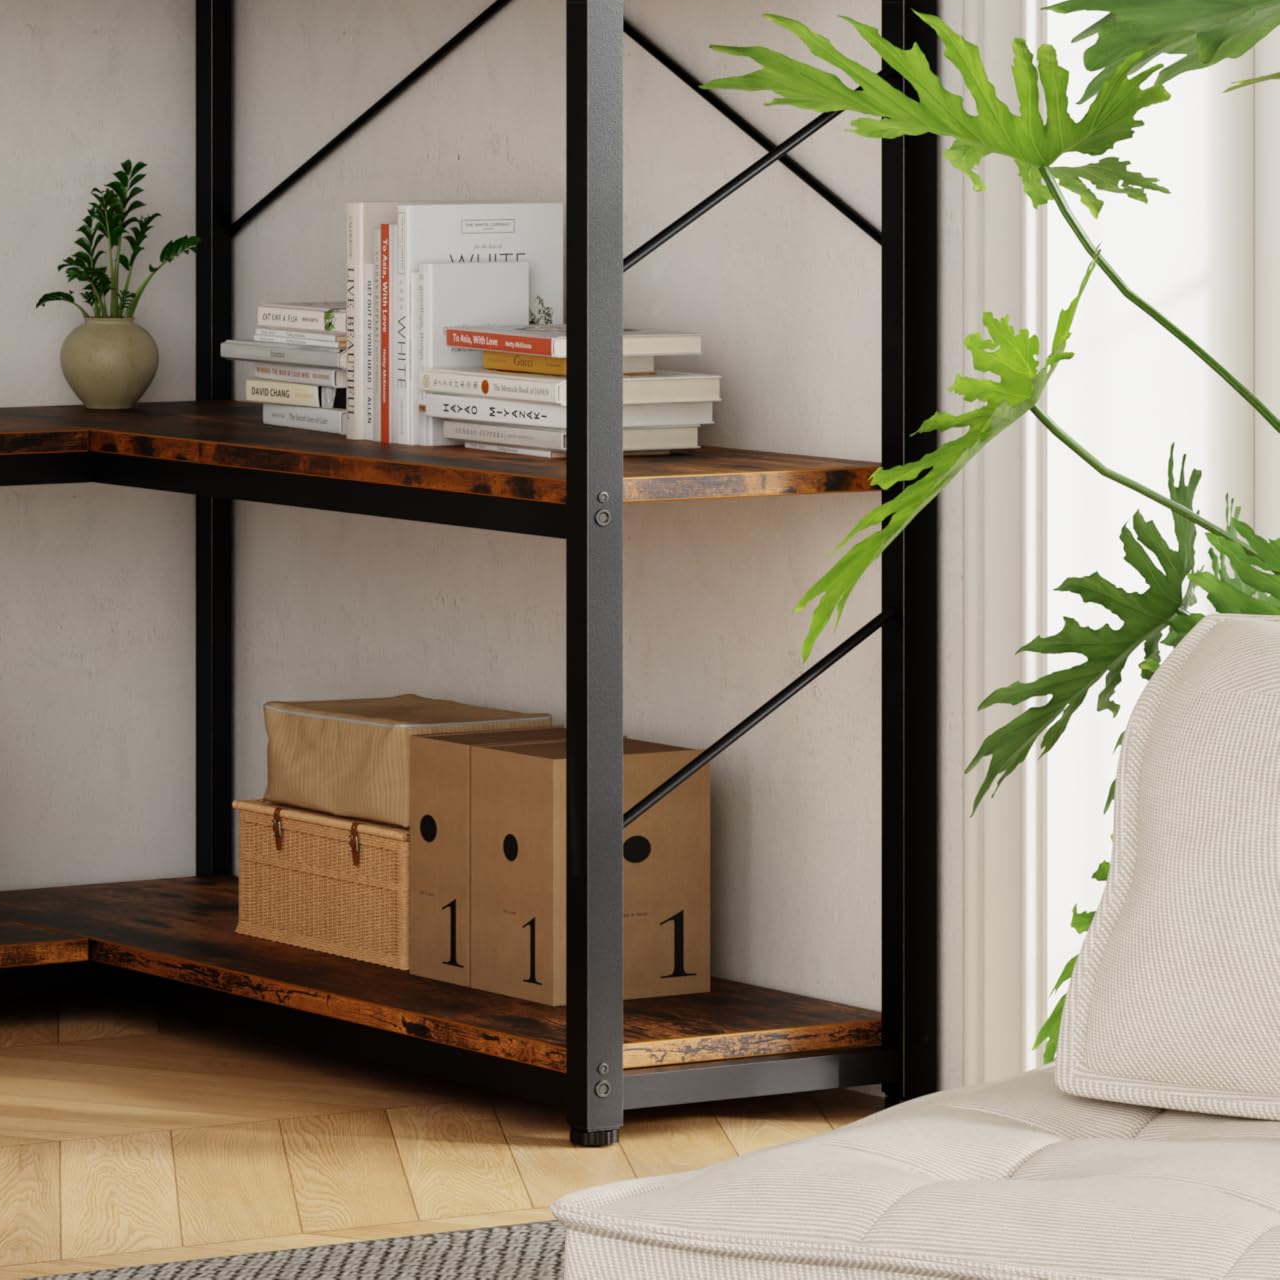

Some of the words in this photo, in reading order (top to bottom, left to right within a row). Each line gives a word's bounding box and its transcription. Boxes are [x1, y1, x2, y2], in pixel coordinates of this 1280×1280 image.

[382, 238, 388, 252] To
[347, 267, 355, 308] LIVE
[397, 315, 406, 389] WHITE
[453, 333, 460, 342] To
[461, 334, 472, 345] Asia,
[473, 334, 485, 345] With
[486, 336, 498, 346] Love
[251, 386, 269, 397] DAVID
[270, 388, 290, 399] CHANG
[347, 316, 355, 420] BEAUTIFUL
[443, 403, 478, 415] HAYAO
[489, 406, 548, 420] MIYAZAKI
[441, 899, 464, 968] 1
[522, 917, 542, 985] 1
[660, 910, 696, 978] 1
